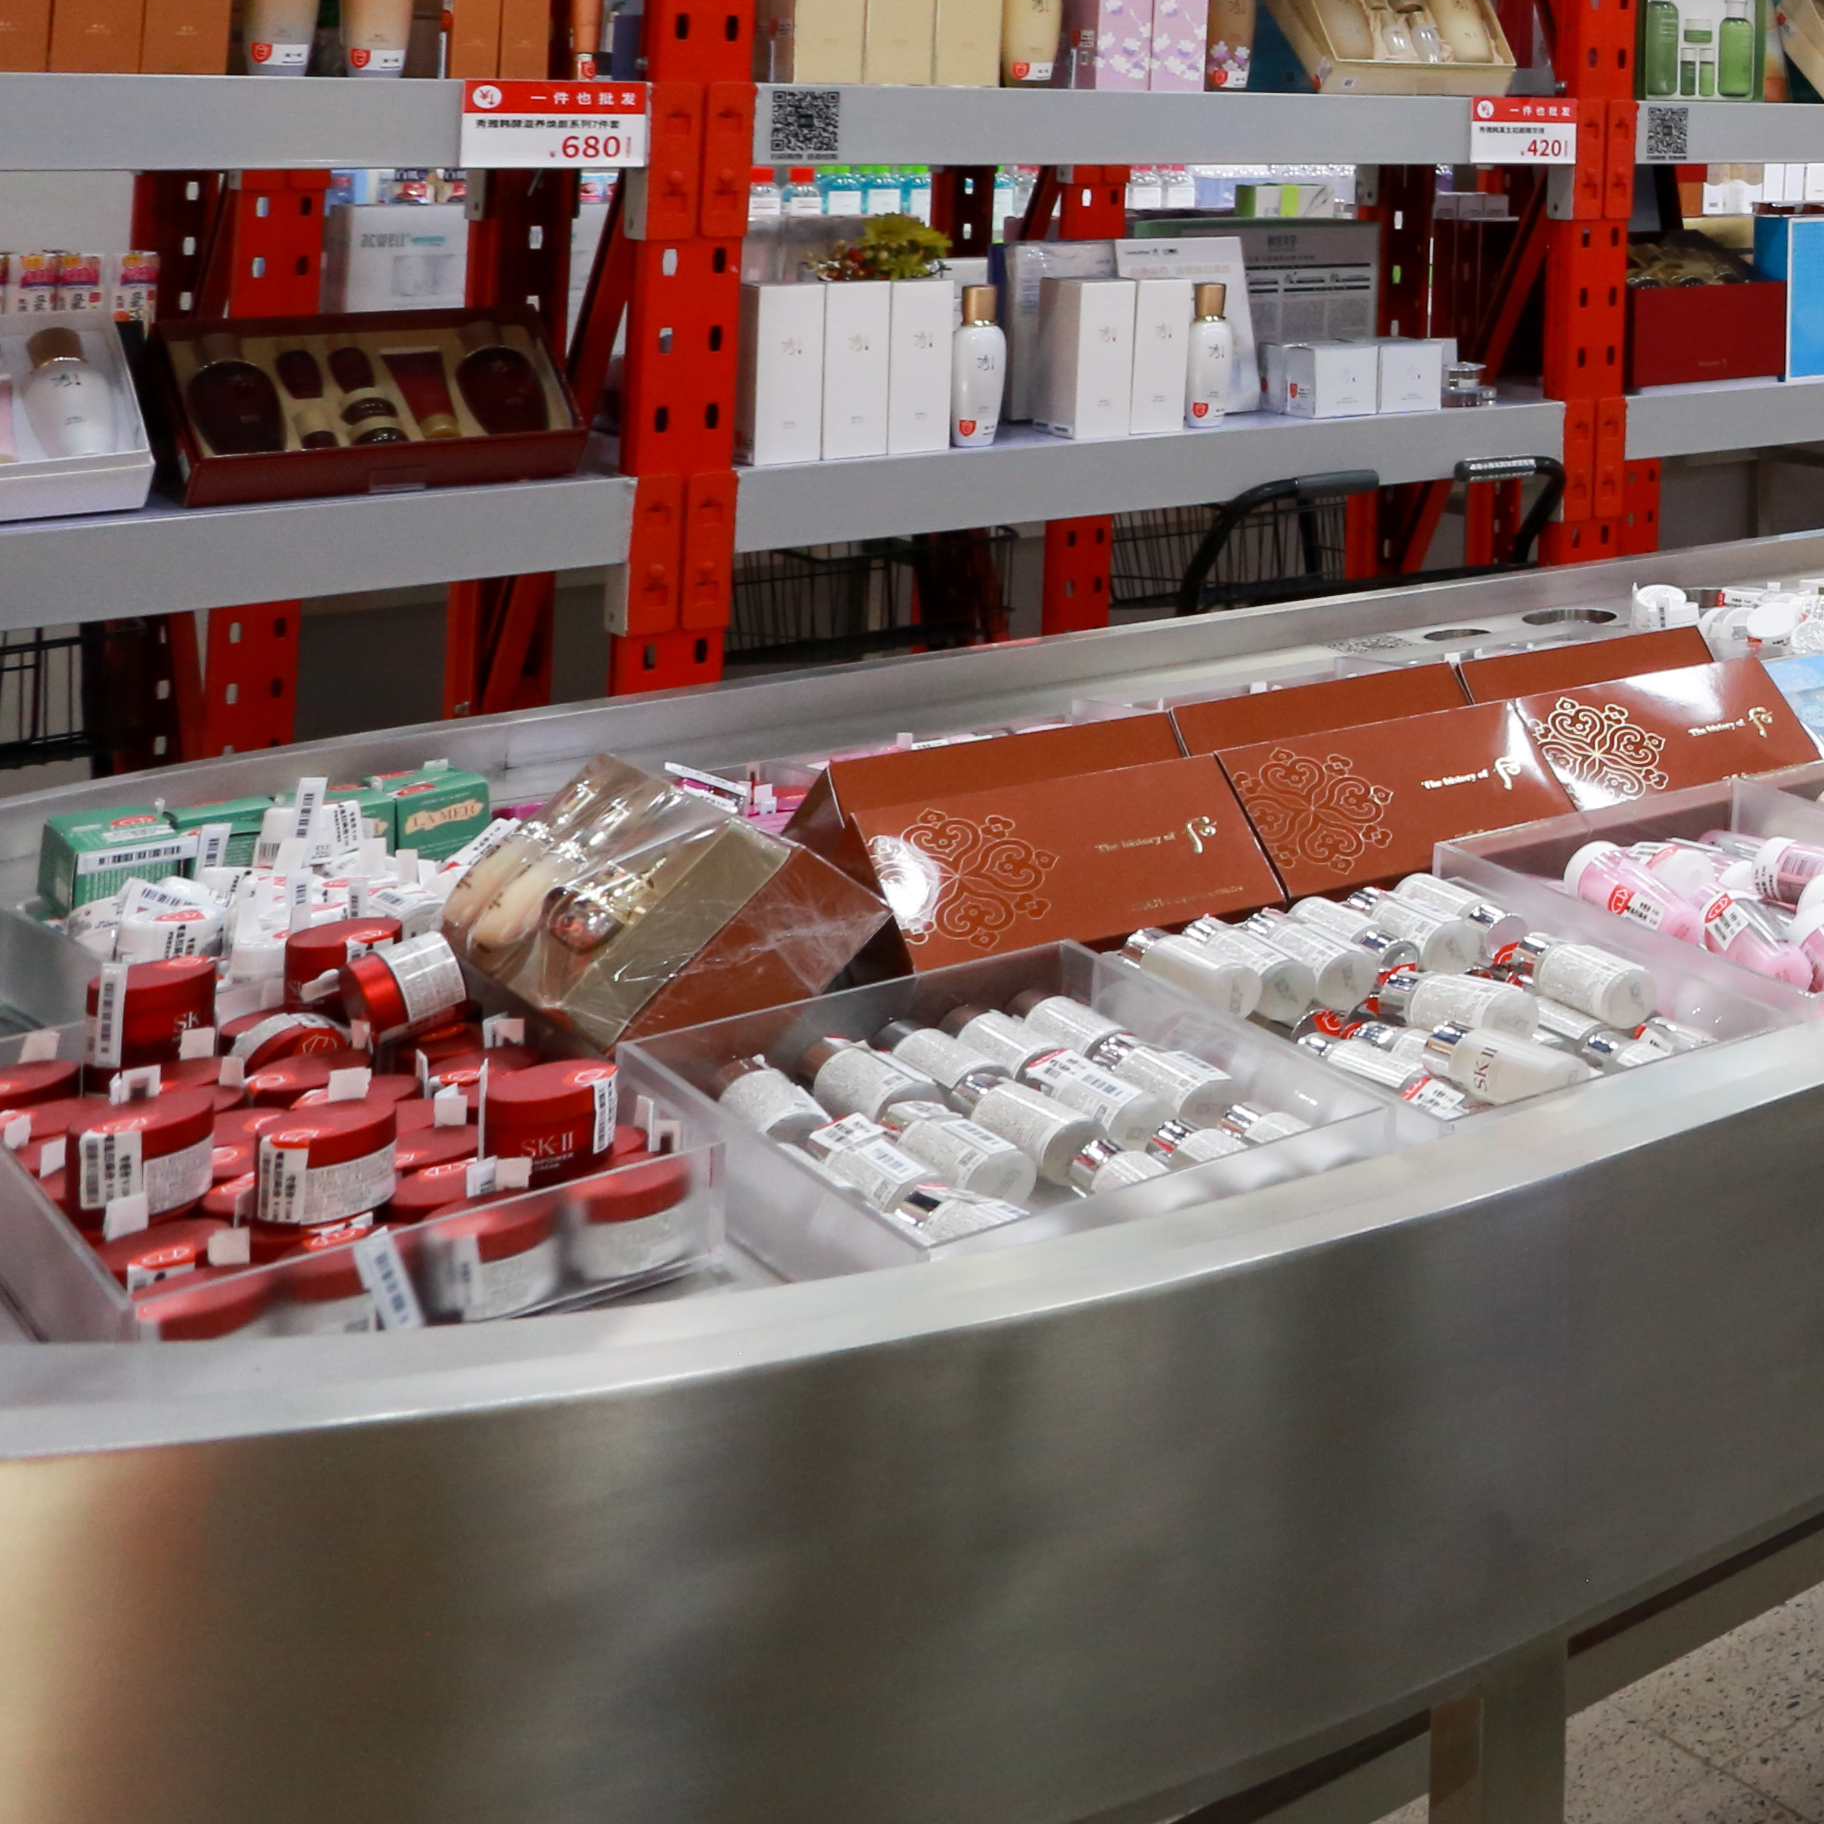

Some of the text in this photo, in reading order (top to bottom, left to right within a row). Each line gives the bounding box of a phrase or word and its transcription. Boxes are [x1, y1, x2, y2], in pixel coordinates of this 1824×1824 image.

[531, 92, 637, 106] 一件也批发
[1421, 778, 1442, 790] The
[1443, 772, 1475, 788] history
[1477, 769, 1489, 781] of
[1095, 840, 1119, 853] The
[1121, 835, 1161, 850] history
[1163, 831, 1175, 843] of
